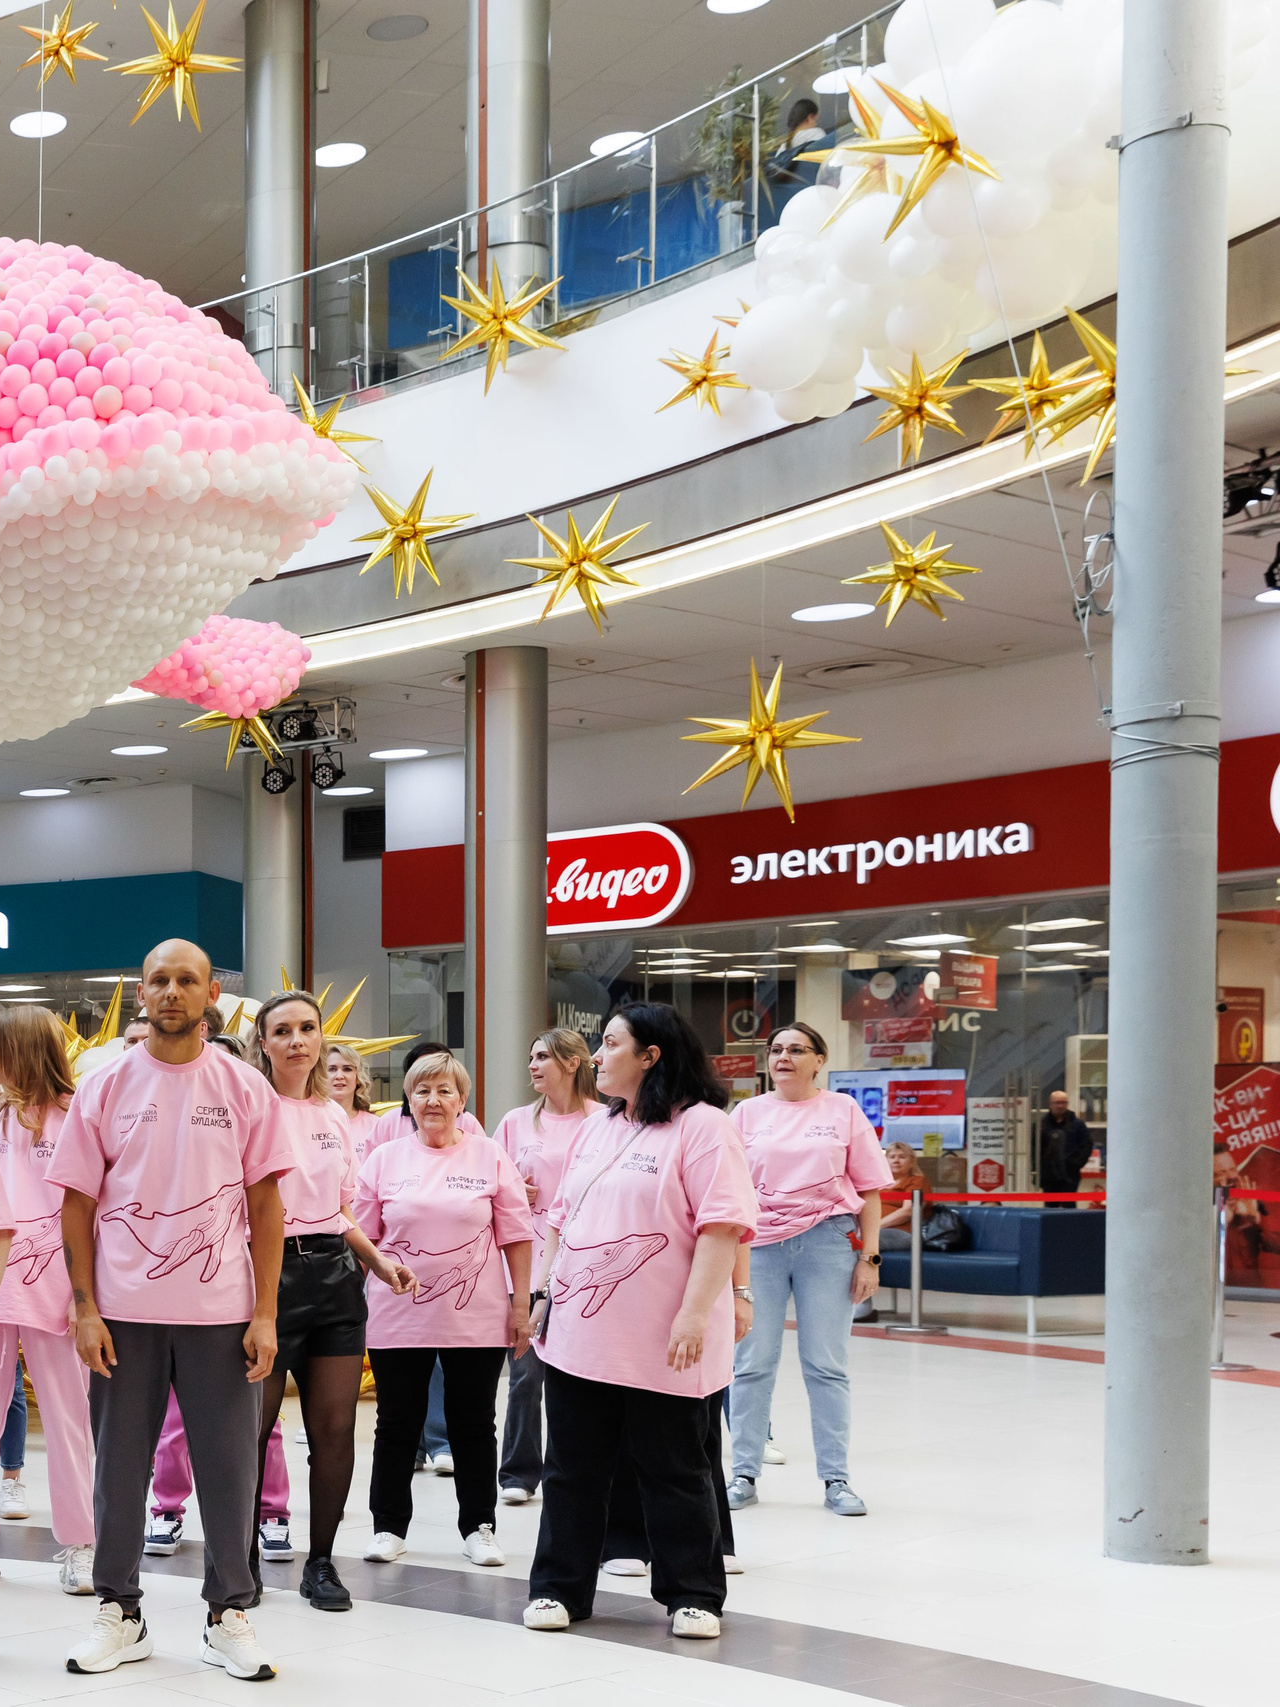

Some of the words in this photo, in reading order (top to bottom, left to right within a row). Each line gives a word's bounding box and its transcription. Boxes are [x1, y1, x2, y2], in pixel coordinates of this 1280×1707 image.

[730, 822, 1030, 885] электроника
[546, 857, 669, 909] .видео
[196, 1106, 228, 1117] СЕРГЕЙ
[191, 1116, 232, 1129] БУЛДАКОВ
[33, 1141, 56, 1150] АНАСТА
